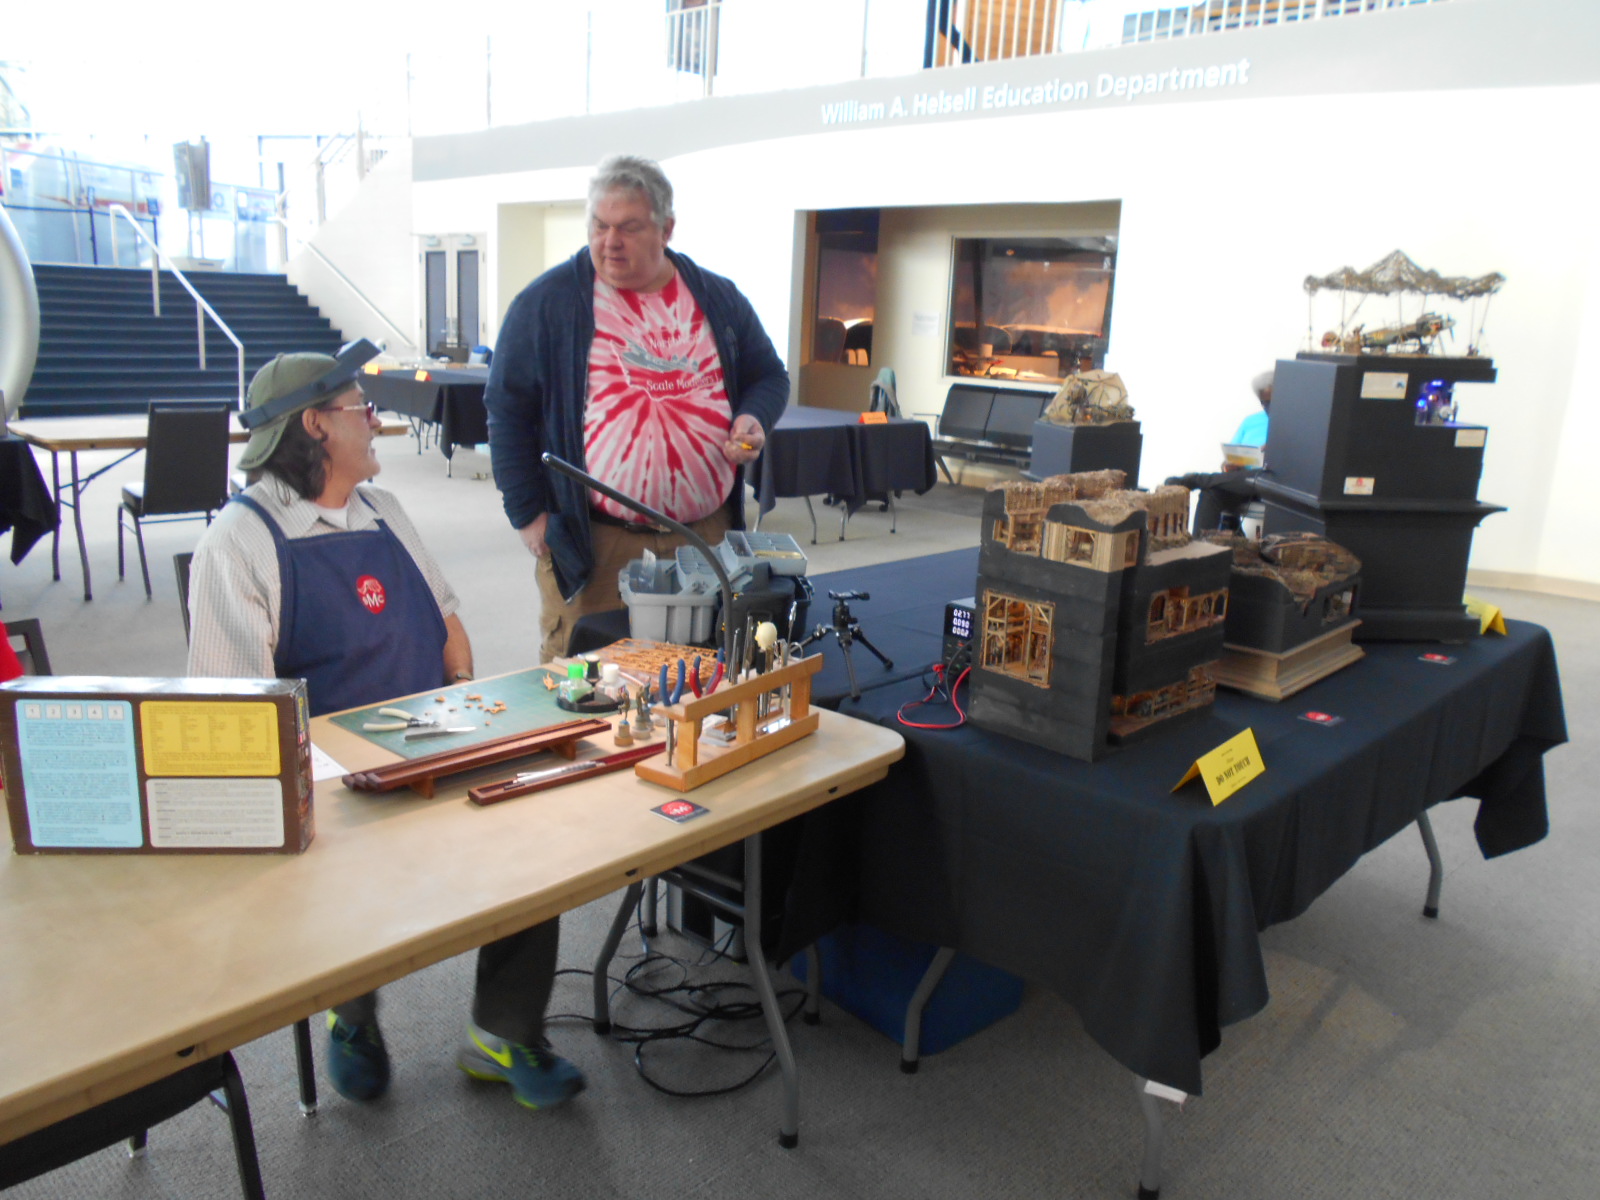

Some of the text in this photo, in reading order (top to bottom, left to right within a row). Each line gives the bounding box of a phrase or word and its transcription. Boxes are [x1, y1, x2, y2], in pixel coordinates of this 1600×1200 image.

[820, 57, 1251, 125] William A. Helsell Education Department
[646, 379, 675, 391] Scale
[1216, 774, 1224, 786] DO
[1223, 768, 1234, 779] NOT
[1233, 756, 1251, 773] TOUCH
